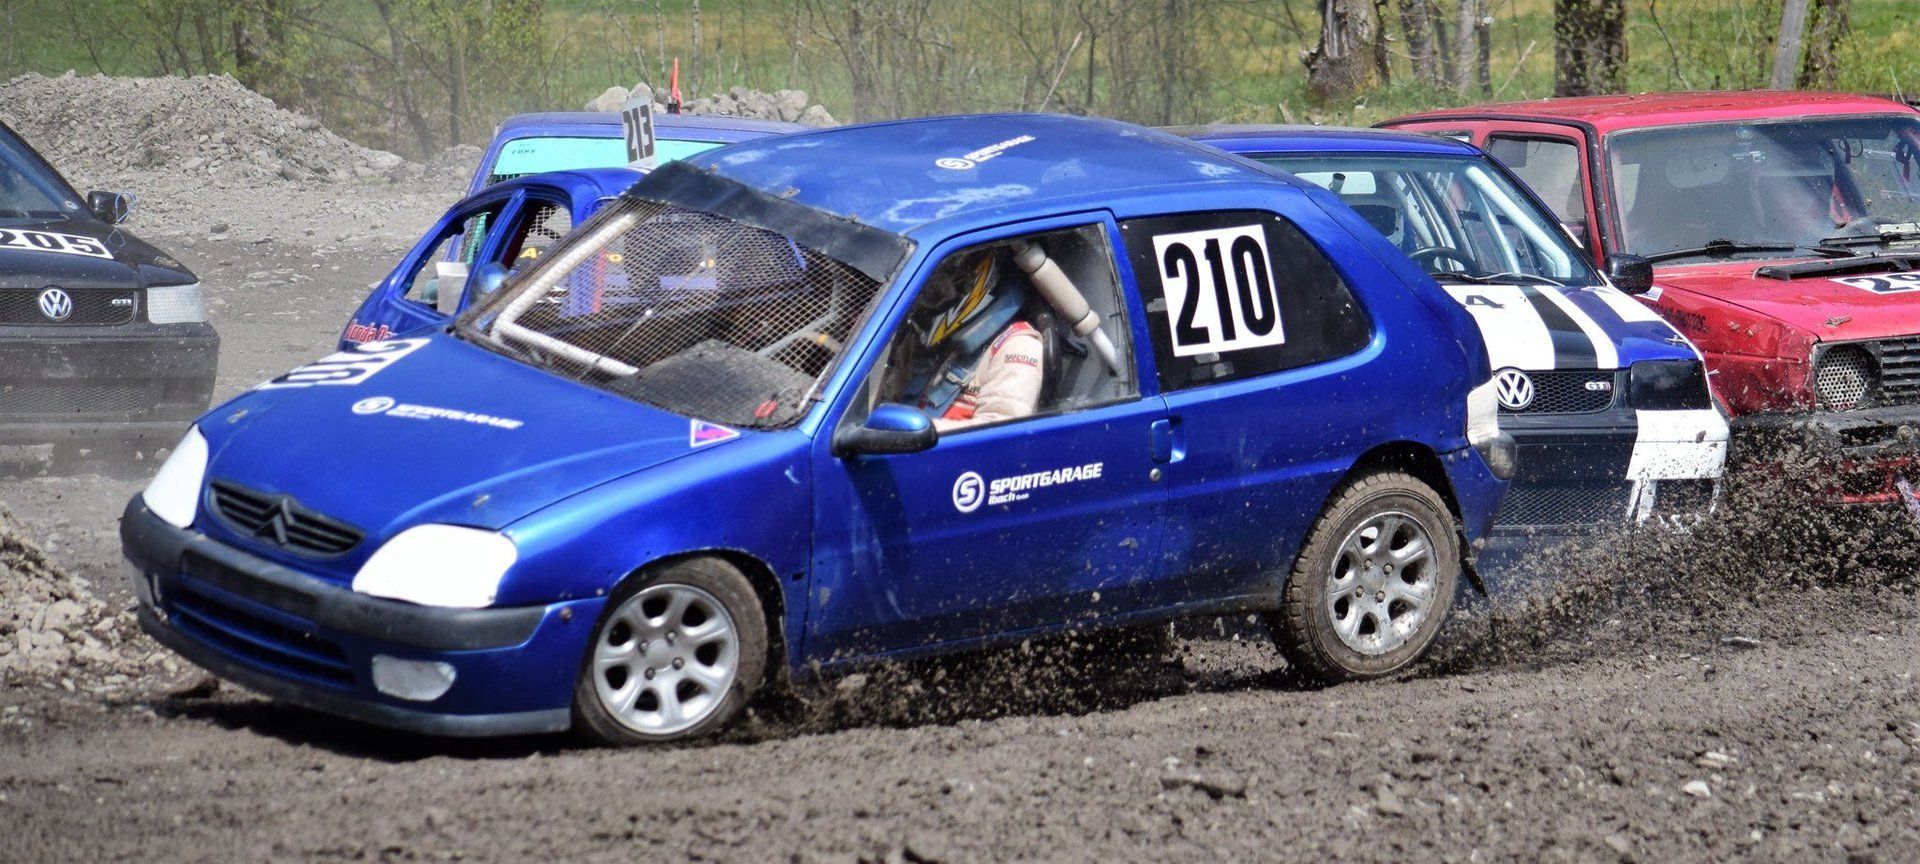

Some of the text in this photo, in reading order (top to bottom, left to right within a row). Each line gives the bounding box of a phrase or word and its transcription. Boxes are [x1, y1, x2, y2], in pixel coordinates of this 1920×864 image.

[622, 104, 655, 163] 213
[1163, 235, 1276, 346] 210
[989, 462, 1104, 495] SPORTGARAGE
